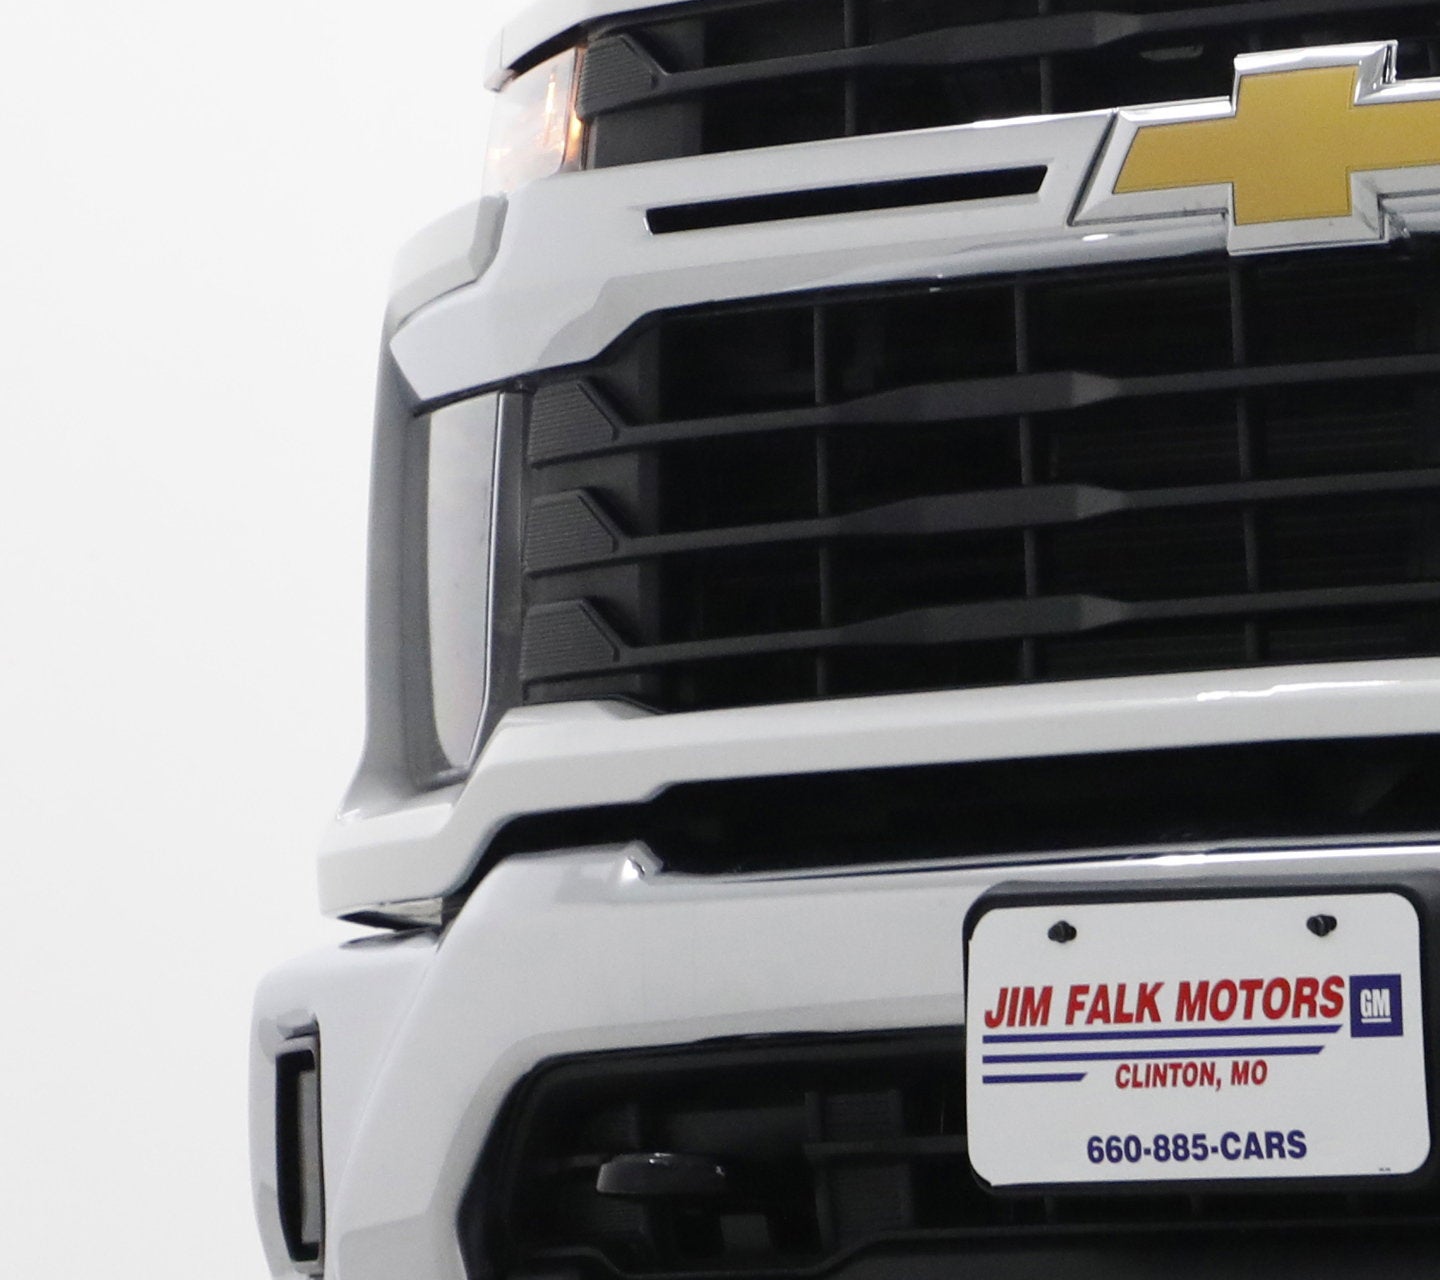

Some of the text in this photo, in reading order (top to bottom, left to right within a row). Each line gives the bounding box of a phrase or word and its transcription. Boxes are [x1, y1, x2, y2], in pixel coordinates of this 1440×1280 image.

[984, 975, 1345, 1029] JIM FALK MOTORS
[1360, 988, 1391, 1018] GM
[1115, 1059, 1269, 1091] CLINTON, MO
[1087, 1129, 1308, 1164] 660-885-CARS
